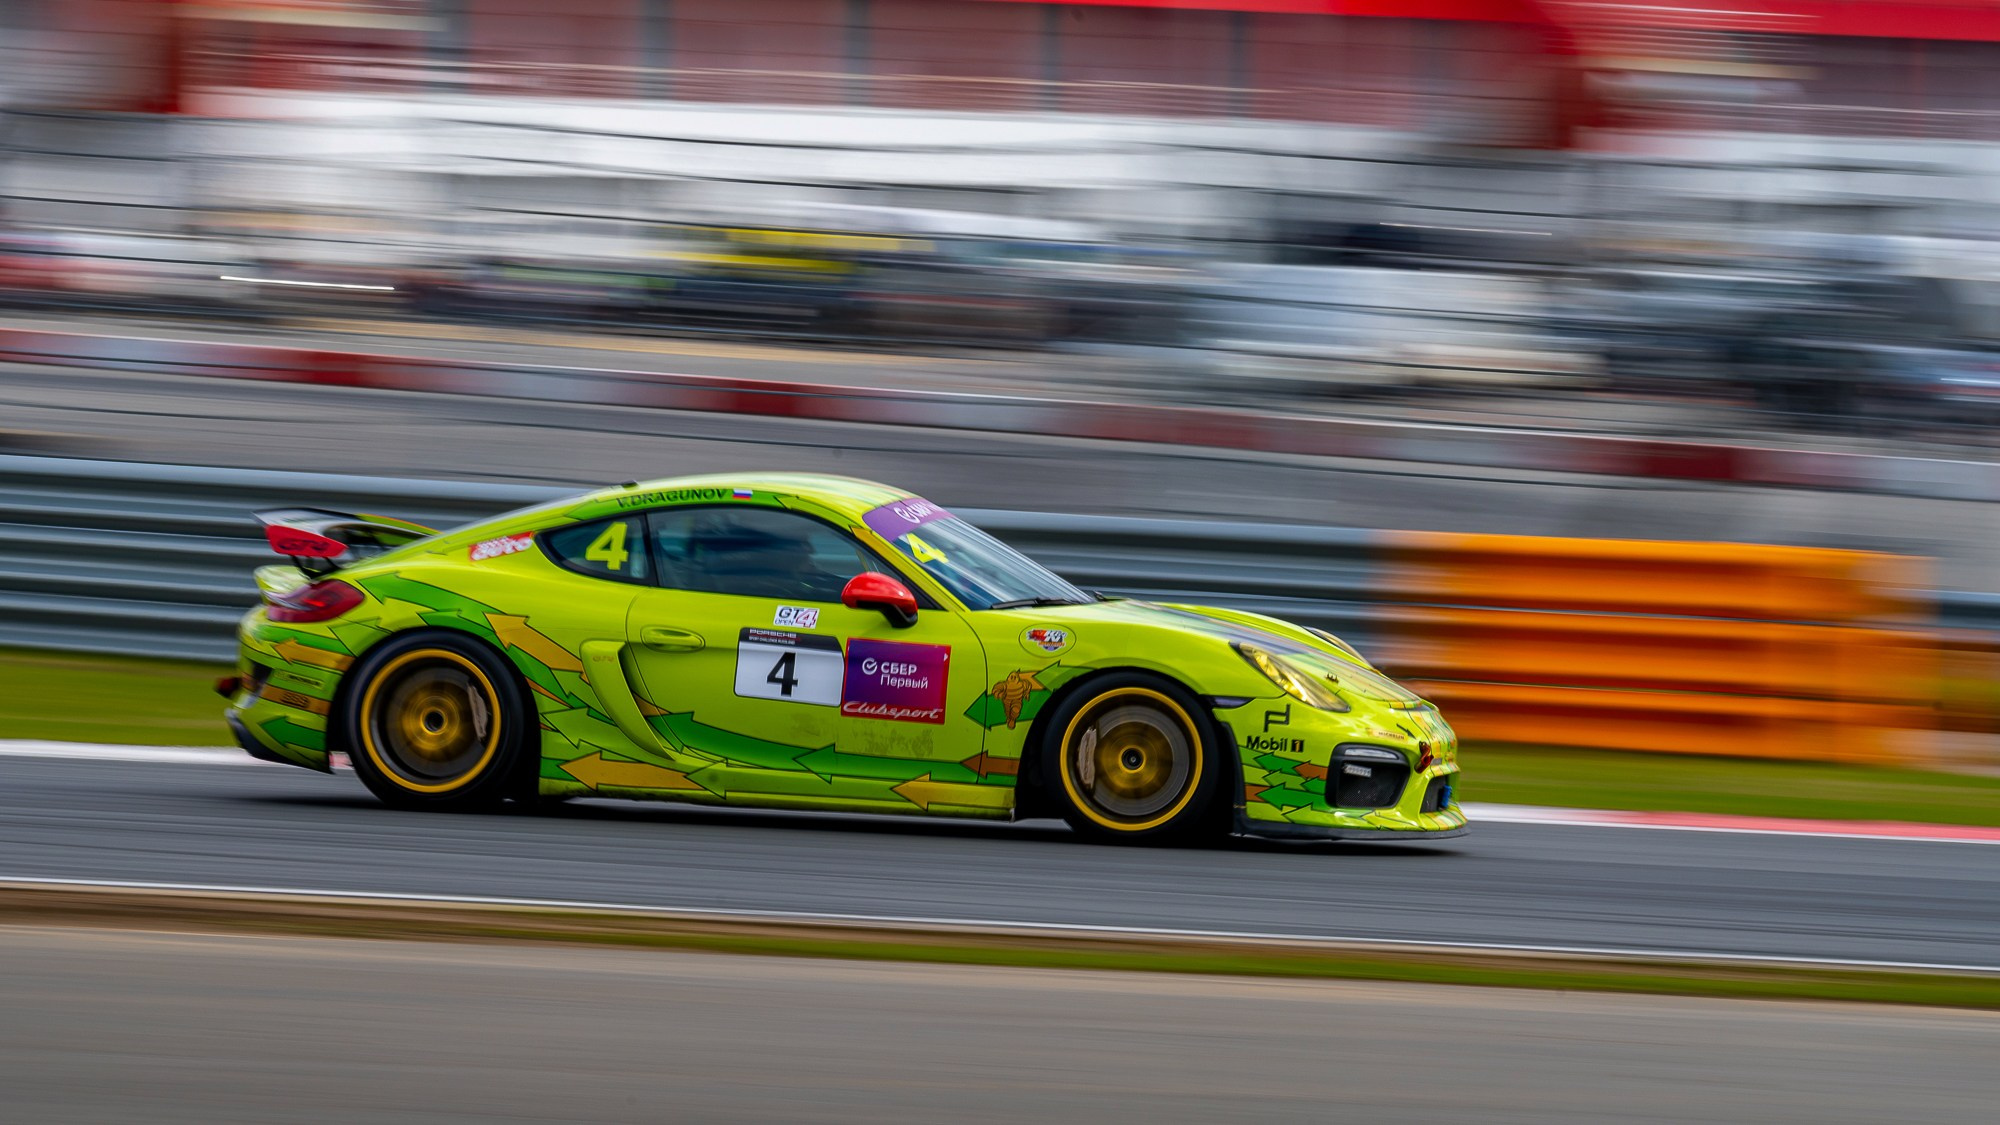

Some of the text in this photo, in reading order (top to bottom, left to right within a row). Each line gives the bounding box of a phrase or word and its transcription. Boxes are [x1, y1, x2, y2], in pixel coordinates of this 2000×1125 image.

[585, 522, 628, 570] 4
[906, 533, 949, 563] 4
[749, 628, 797, 639] PORSCHE
[766, 652, 799, 697] 4
[881, 661, 918, 676] СБЕР
[880, 674, 929, 690] Первый
[843, 700, 944, 720] Clubsport
[1246, 735, 1288, 752] Mobil
